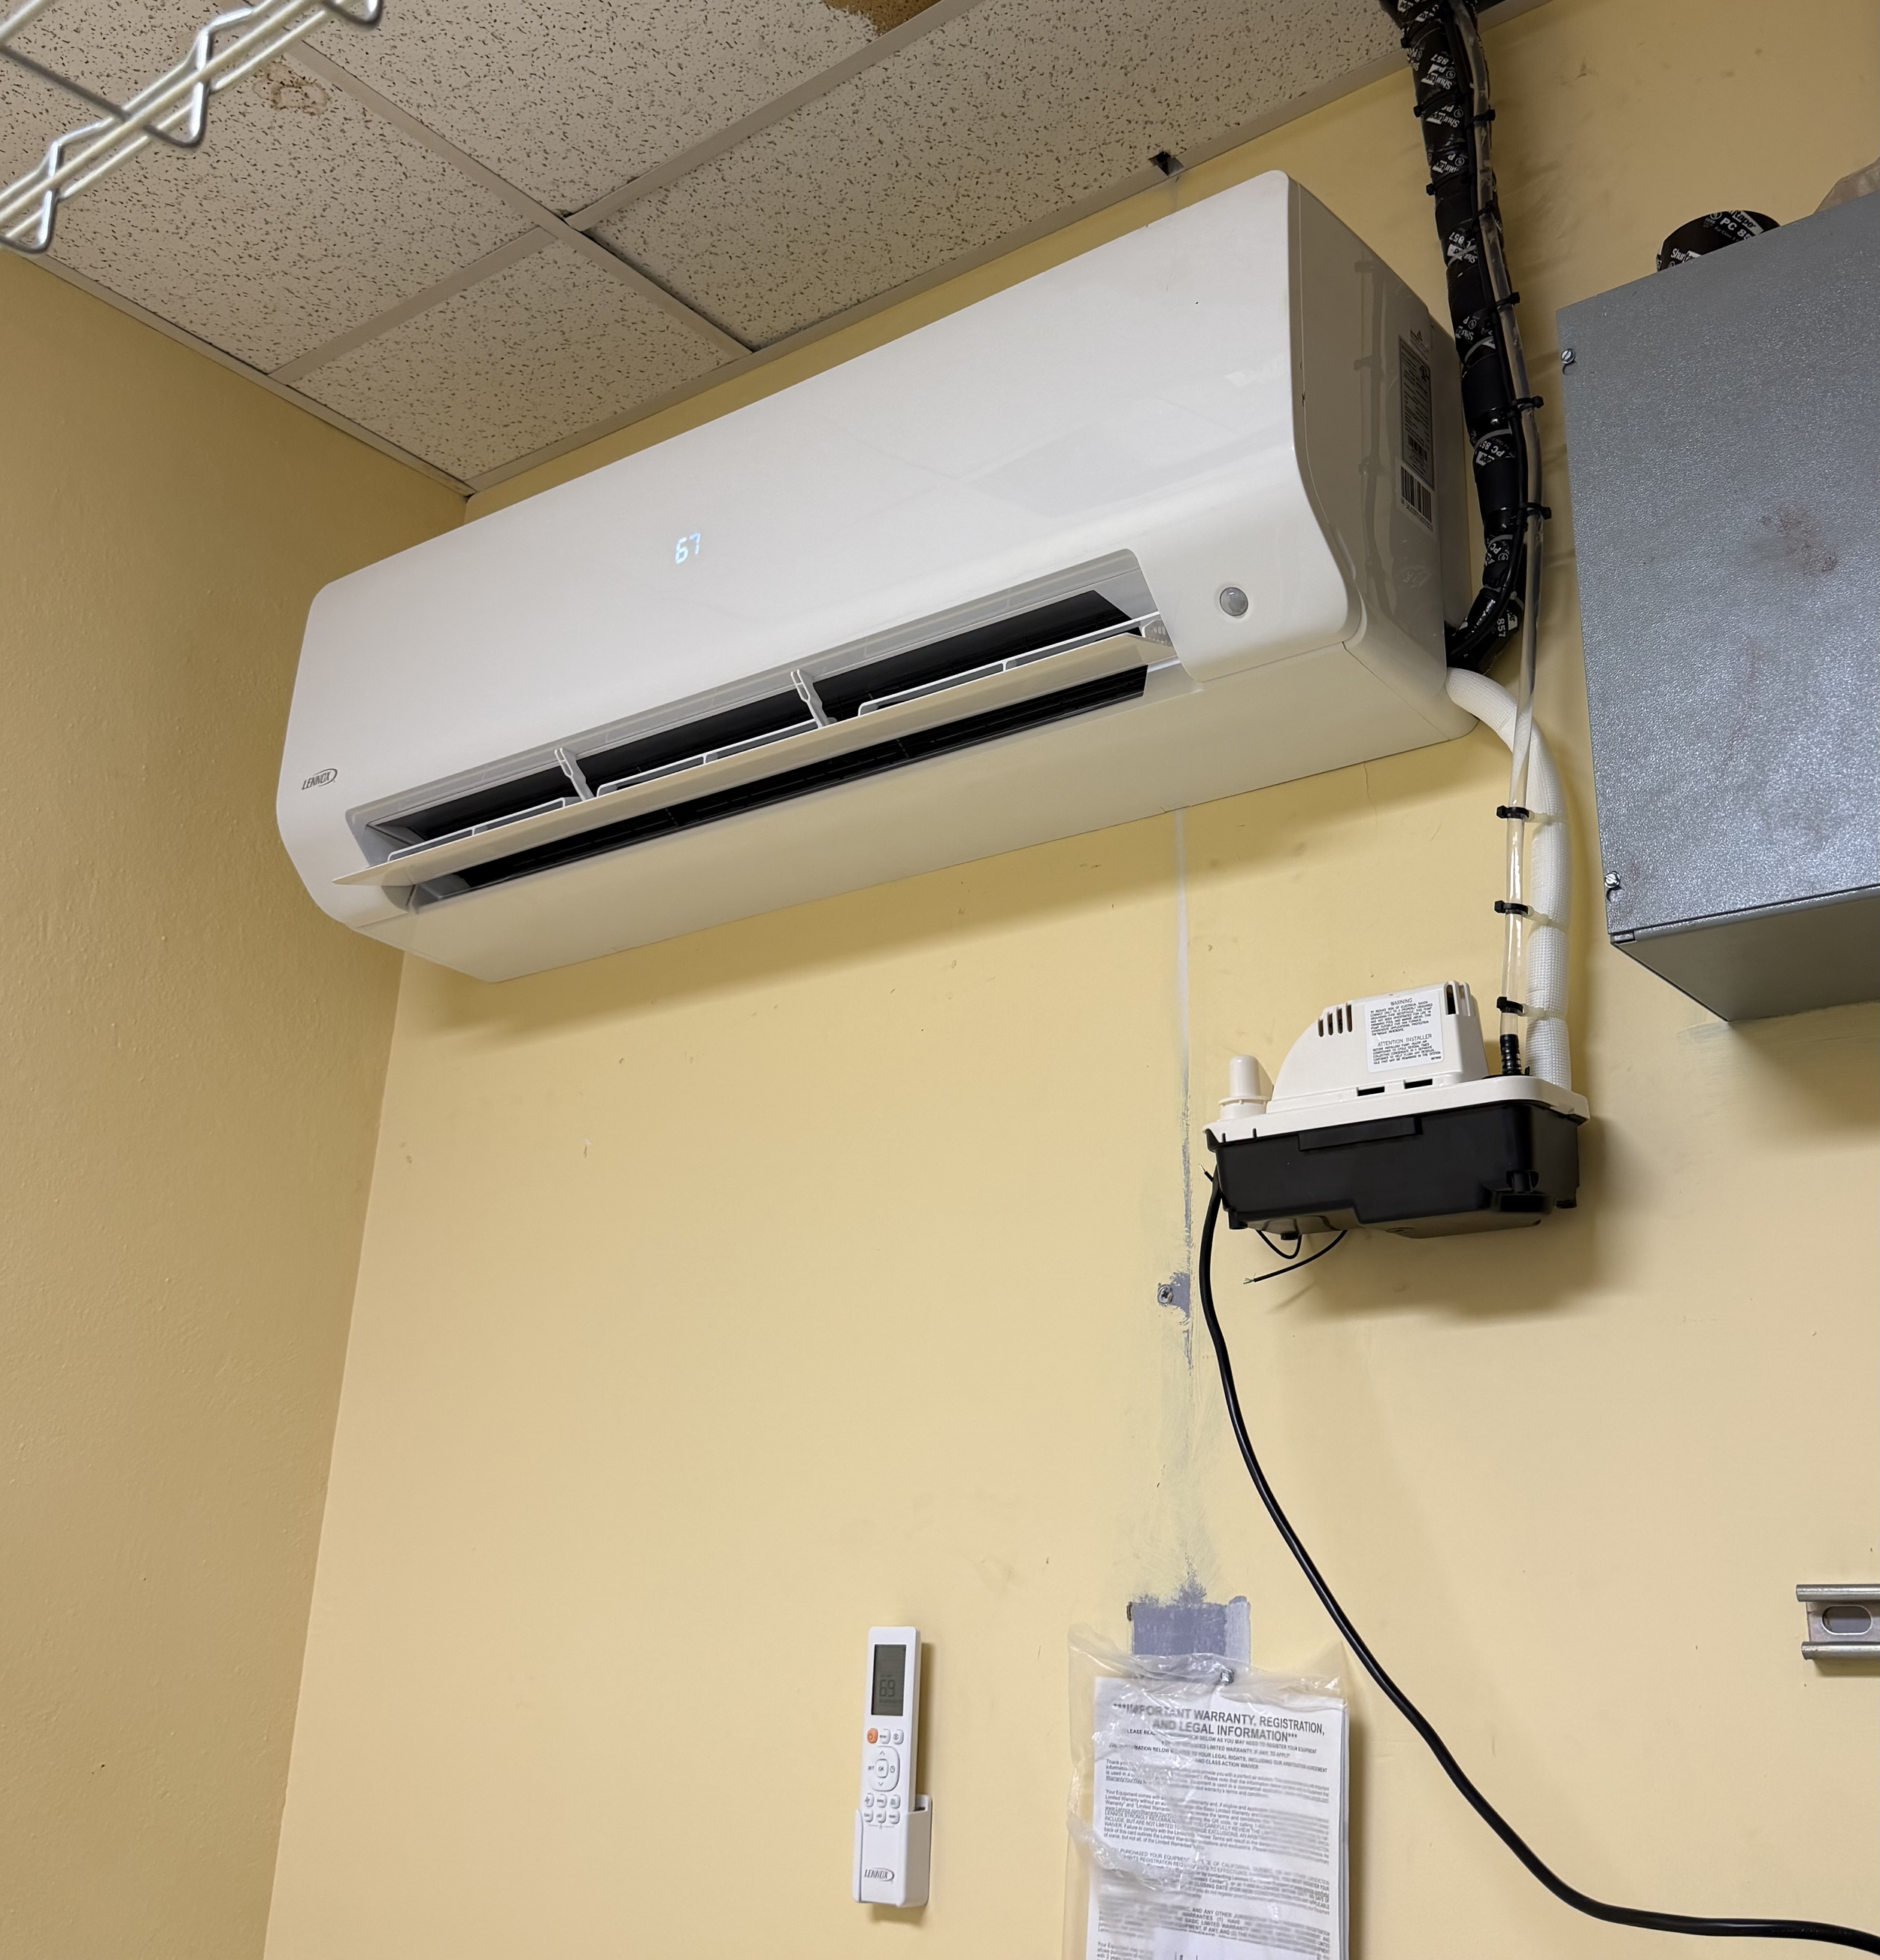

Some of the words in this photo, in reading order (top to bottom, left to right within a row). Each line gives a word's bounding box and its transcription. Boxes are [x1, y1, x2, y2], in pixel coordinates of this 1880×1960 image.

[1430, 54, 1448, 65] 857
[1720, 217, 1737, 231] PC
[1737, 229, 1752, 241] 85
[1448, 232, 1465, 245] 857
[1479, 441, 1491, 450] 85
[1491, 445, 1506, 457] PC
[675, 532, 700, 564] 67
[1489, 542, 1502, 554] PC
[1496, 618, 1506, 638] 857
[302, 770, 334, 790] LENNOX
[1390, 998, 1412, 1006] WARNING
[1406, 1033, 1432, 1041] INSTALLER
[879, 1679, 896, 1697] 69
[1153, 1719, 1177, 1729] AND
[1179, 1722, 1214, 1734] LEGAL
[1194, 1710, 1257, 1726] WARRANTY,
[1260, 1716, 1325, 1736] REGISTRATION,
[1116, 1789, 1138, 1798] Equipment
[1120, 1848, 1148, 1857] PURCHASED
[1139, 1856, 1172, 1866] REGISTRATION
[864, 1868, 891, 1880] LENNOX
[1182, 1912, 1213, 1921] WARRANTIES
